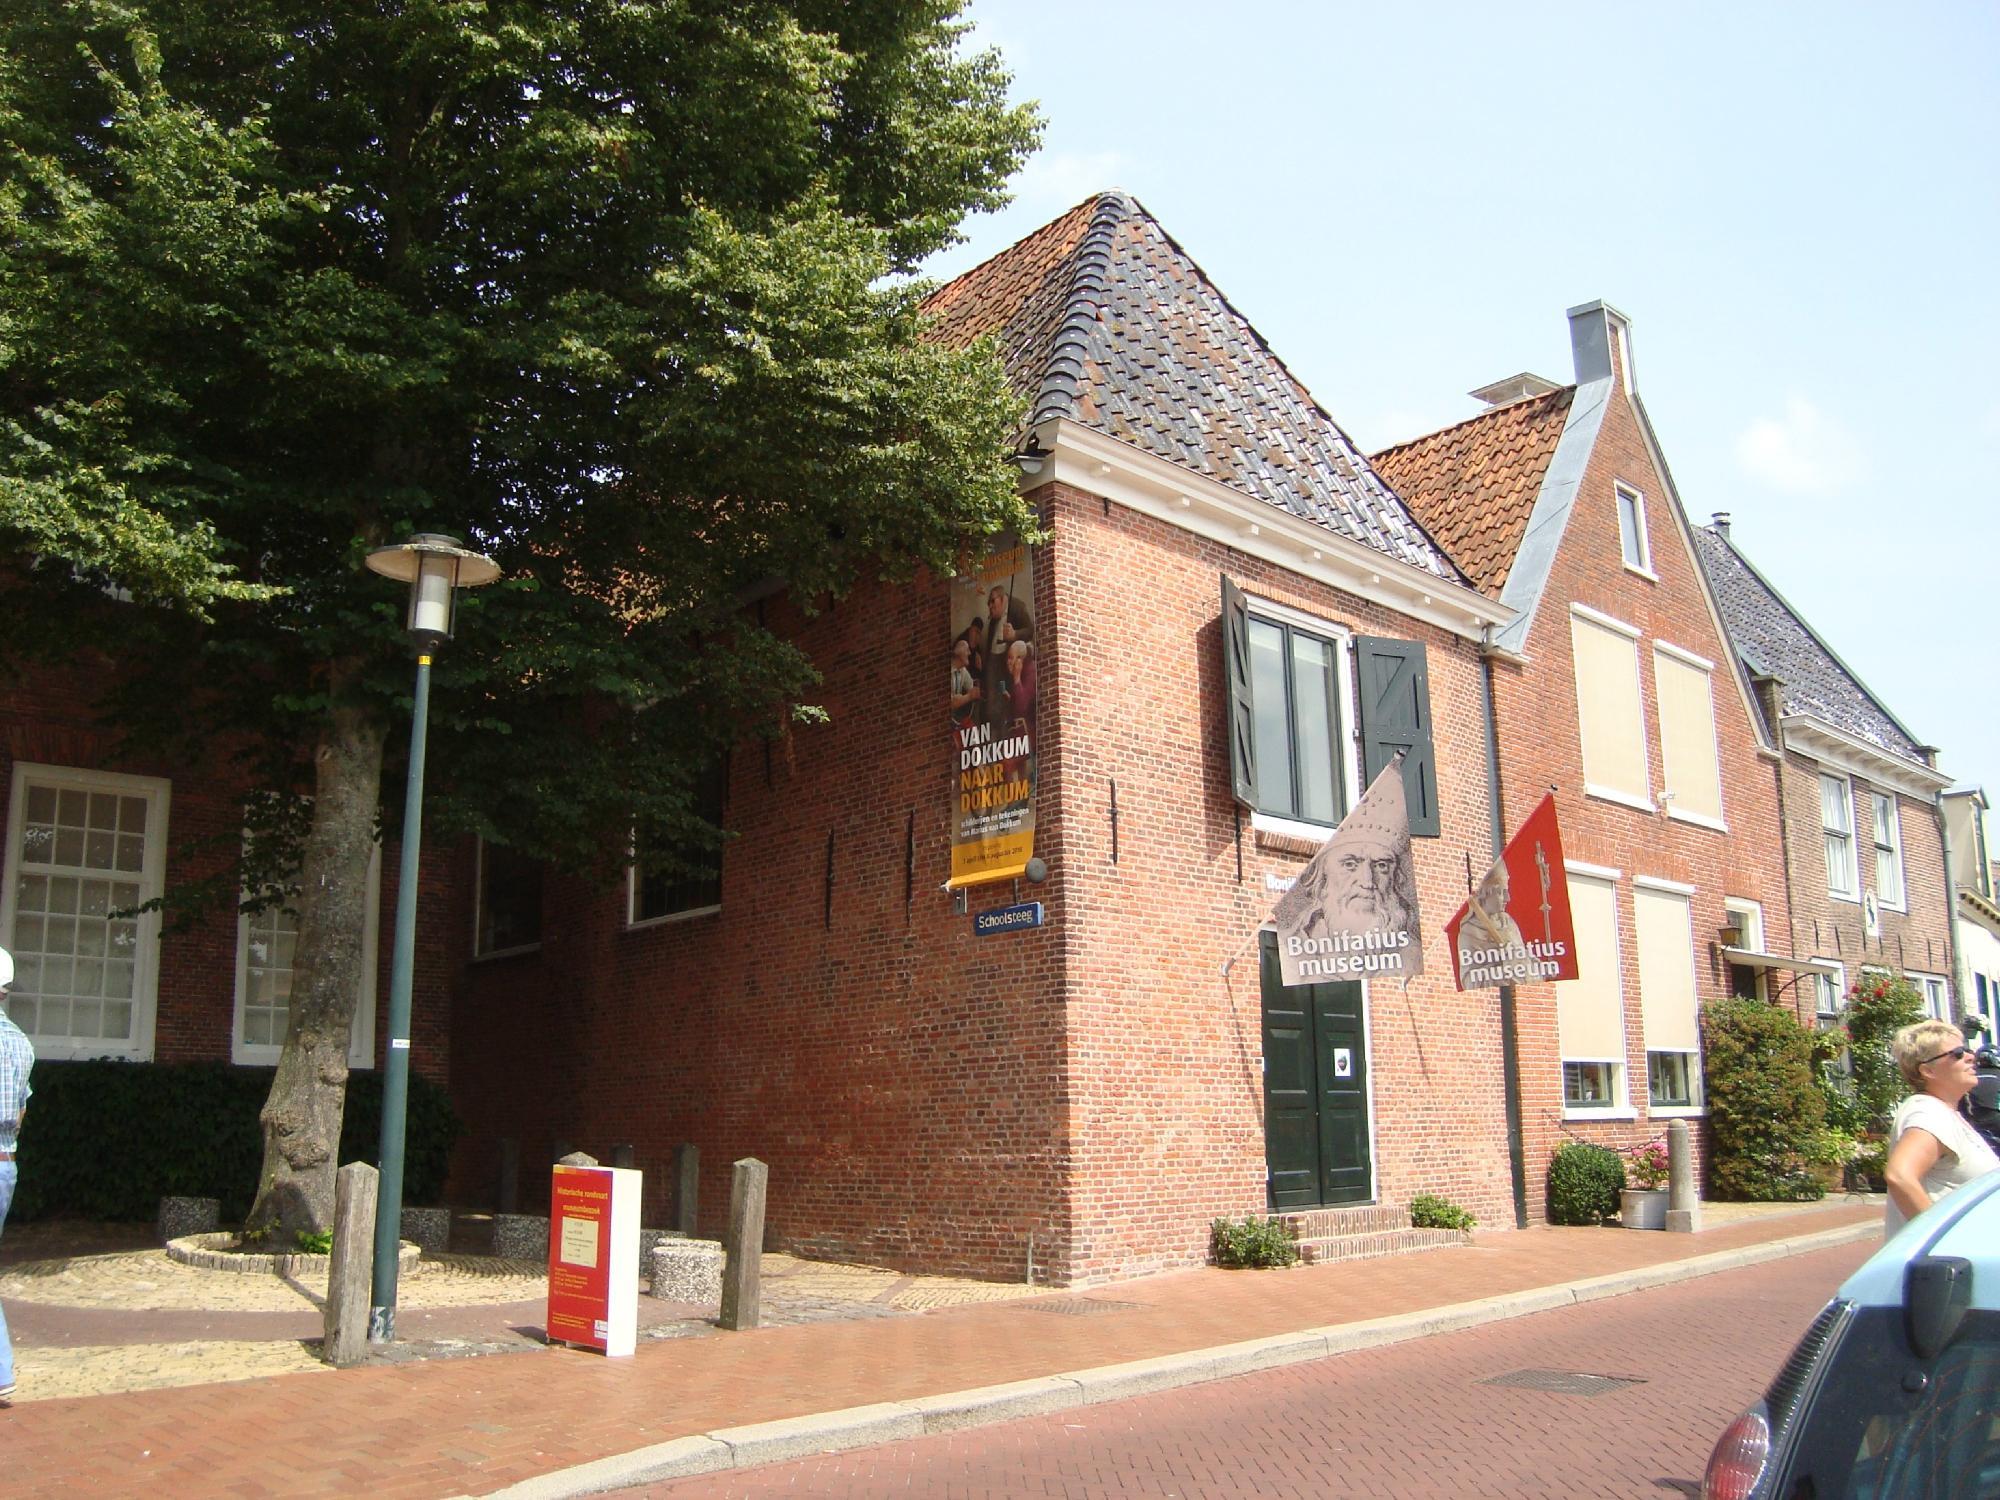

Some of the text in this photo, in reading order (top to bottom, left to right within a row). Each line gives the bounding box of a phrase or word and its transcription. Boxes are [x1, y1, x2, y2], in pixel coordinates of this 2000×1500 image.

[960, 722, 991, 747] VAN
[961, 735, 1030, 770] DOKKUM
[961, 763, 1004, 791] NAAR
[960, 779, 1029, 813] DOKKUM
[999, 807, 1030, 820] tekeningen
[1000, 819, 1022, 829] Dokkum
[979, 910, 1033, 928] Schoolsteeg
[1287, 928, 1409, 956] Bonifatius
[1460, 938, 1566, 966] Bonifatius
[1298, 952, 1402, 976] museum
[1470, 960, 1560, 983] museum
